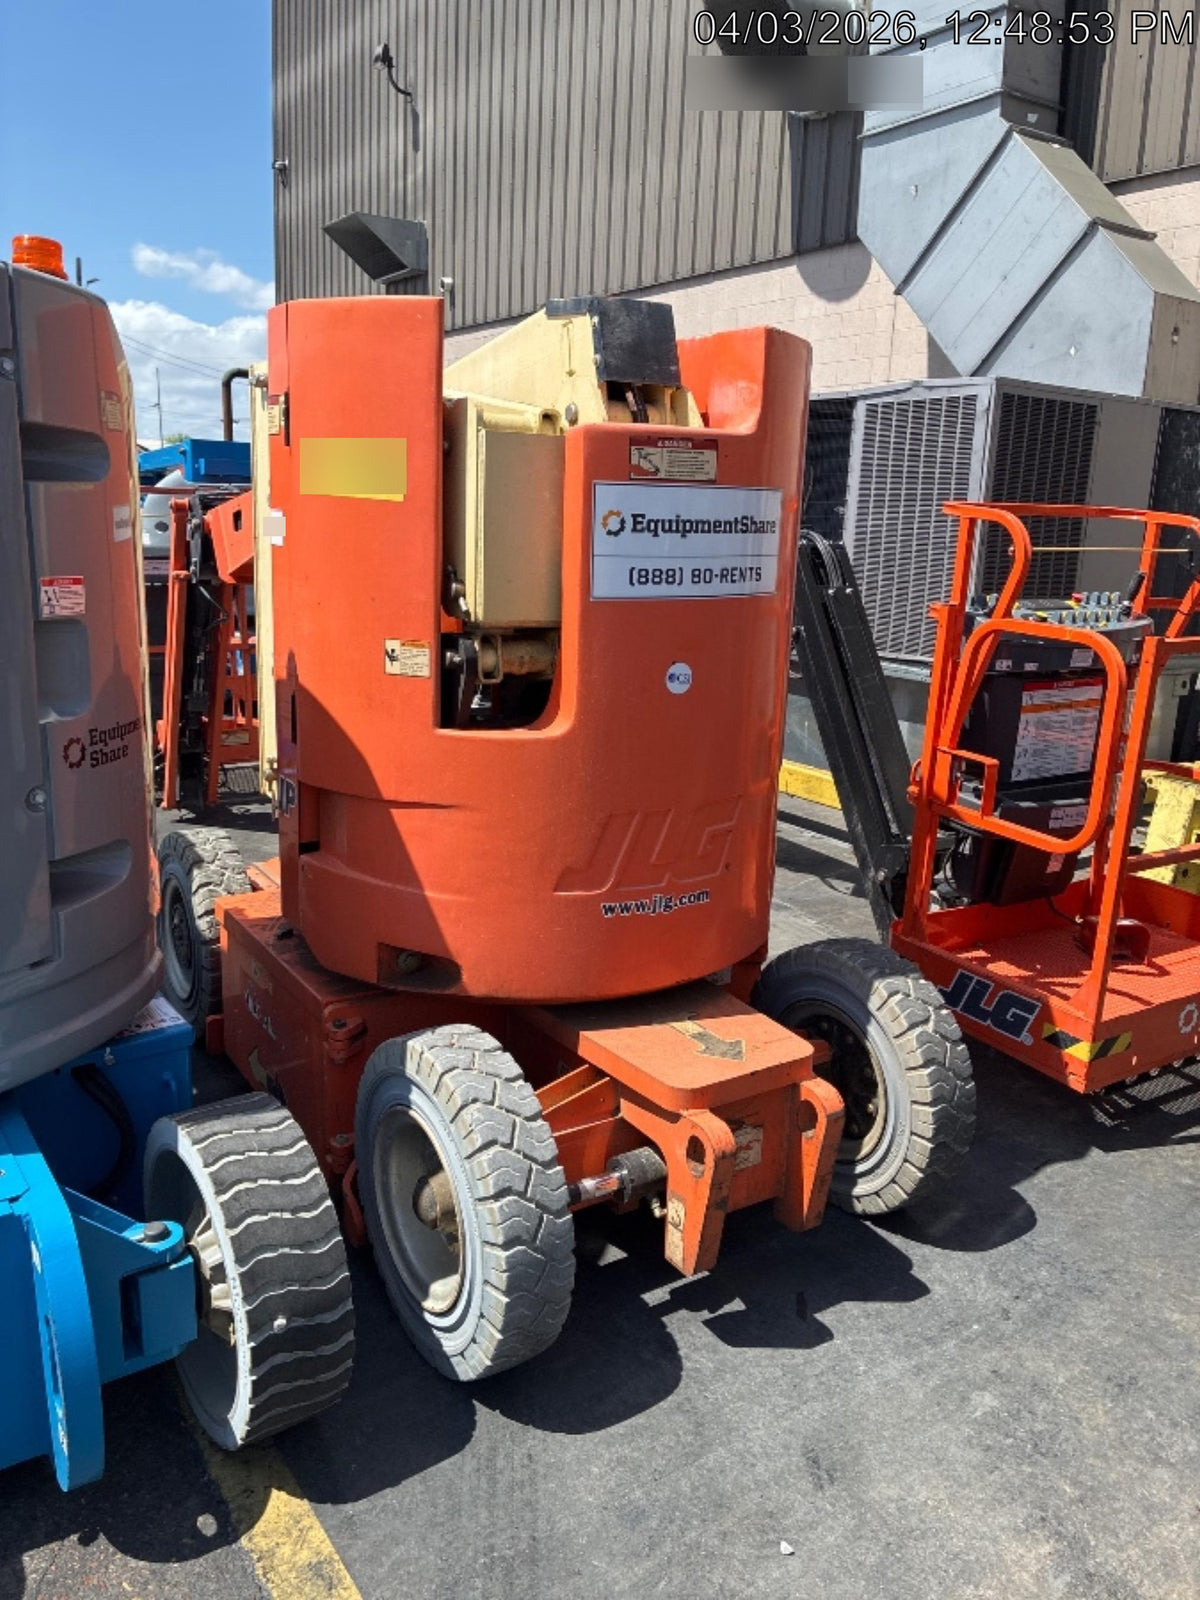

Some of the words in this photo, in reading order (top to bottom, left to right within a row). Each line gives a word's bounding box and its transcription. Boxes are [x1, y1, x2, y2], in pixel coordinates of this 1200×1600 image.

[630, 512, 776, 539] EquipmentShare
[628, 566, 684, 587] (888)
[690, 566, 762, 585] 80-RENTS
[89, 744, 129, 768] Share
[552, 795, 744, 896] JLG
[601, 888, 711, 919] www.jlg.com
[936, 968, 1043, 1043] JLG
